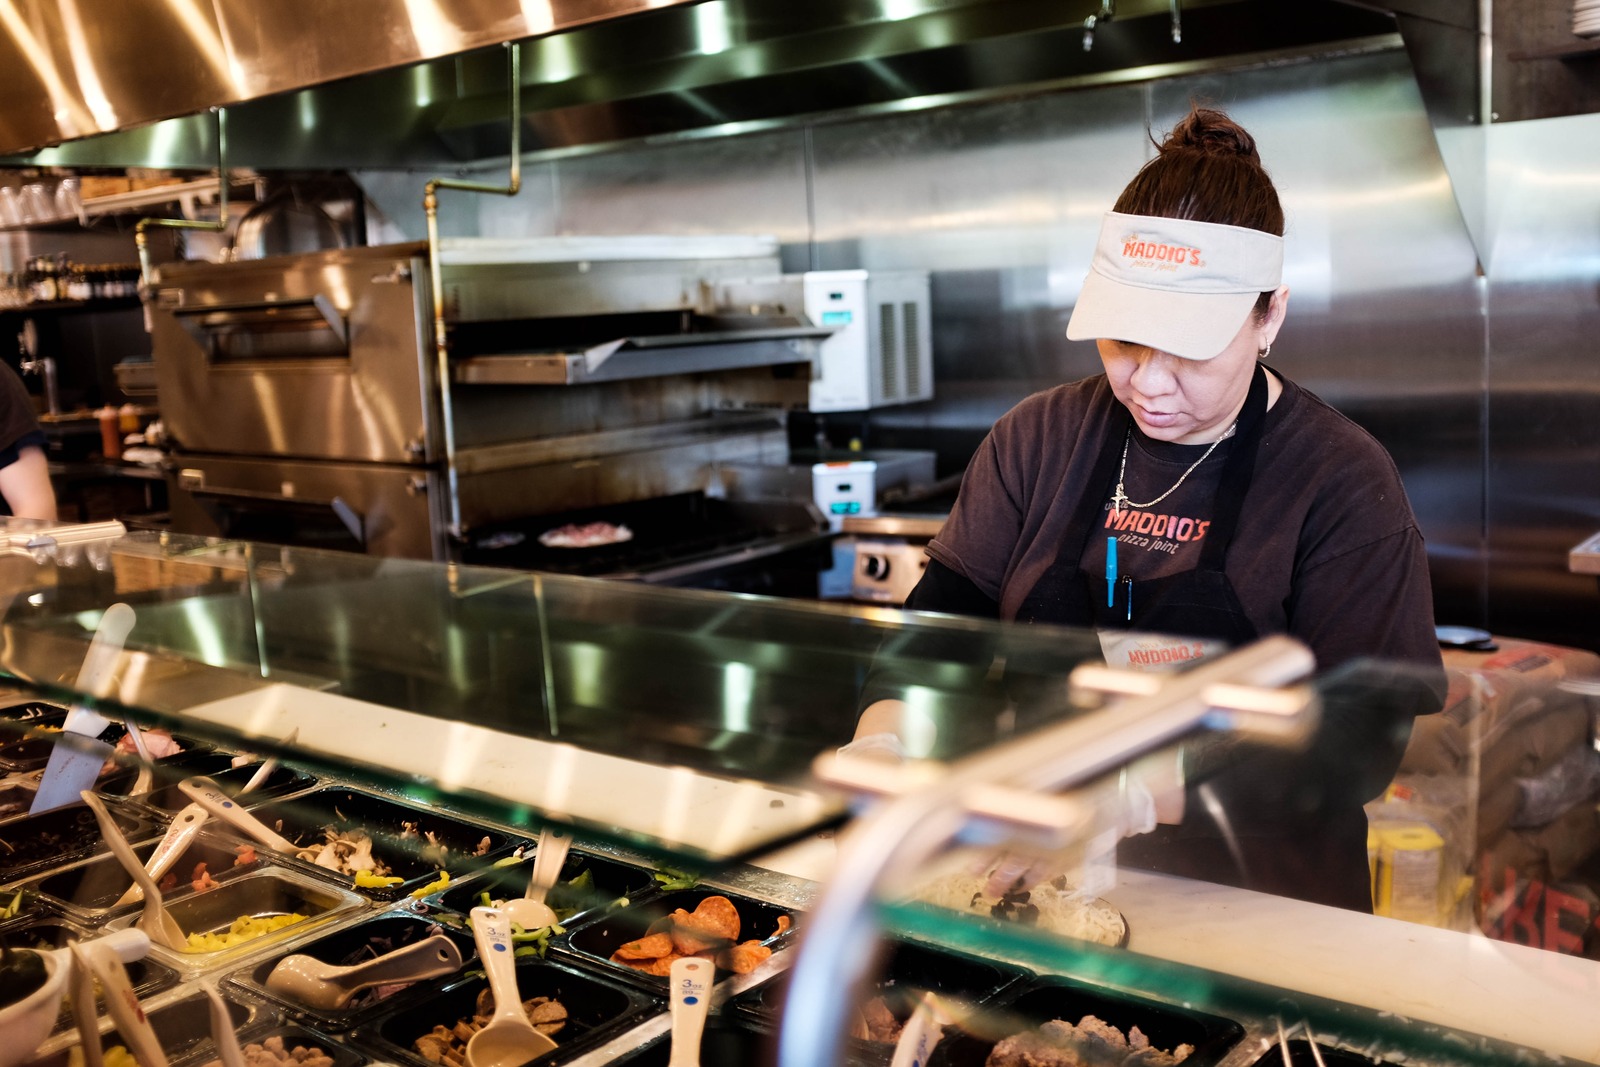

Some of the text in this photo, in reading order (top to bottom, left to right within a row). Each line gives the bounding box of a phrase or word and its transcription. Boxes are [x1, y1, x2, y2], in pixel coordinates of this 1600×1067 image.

[1122, 241, 1202, 268] MADDIO'S
[1104, 508, 1211, 542] MADDIO'S
[1147, 537, 1180, 555] joint
